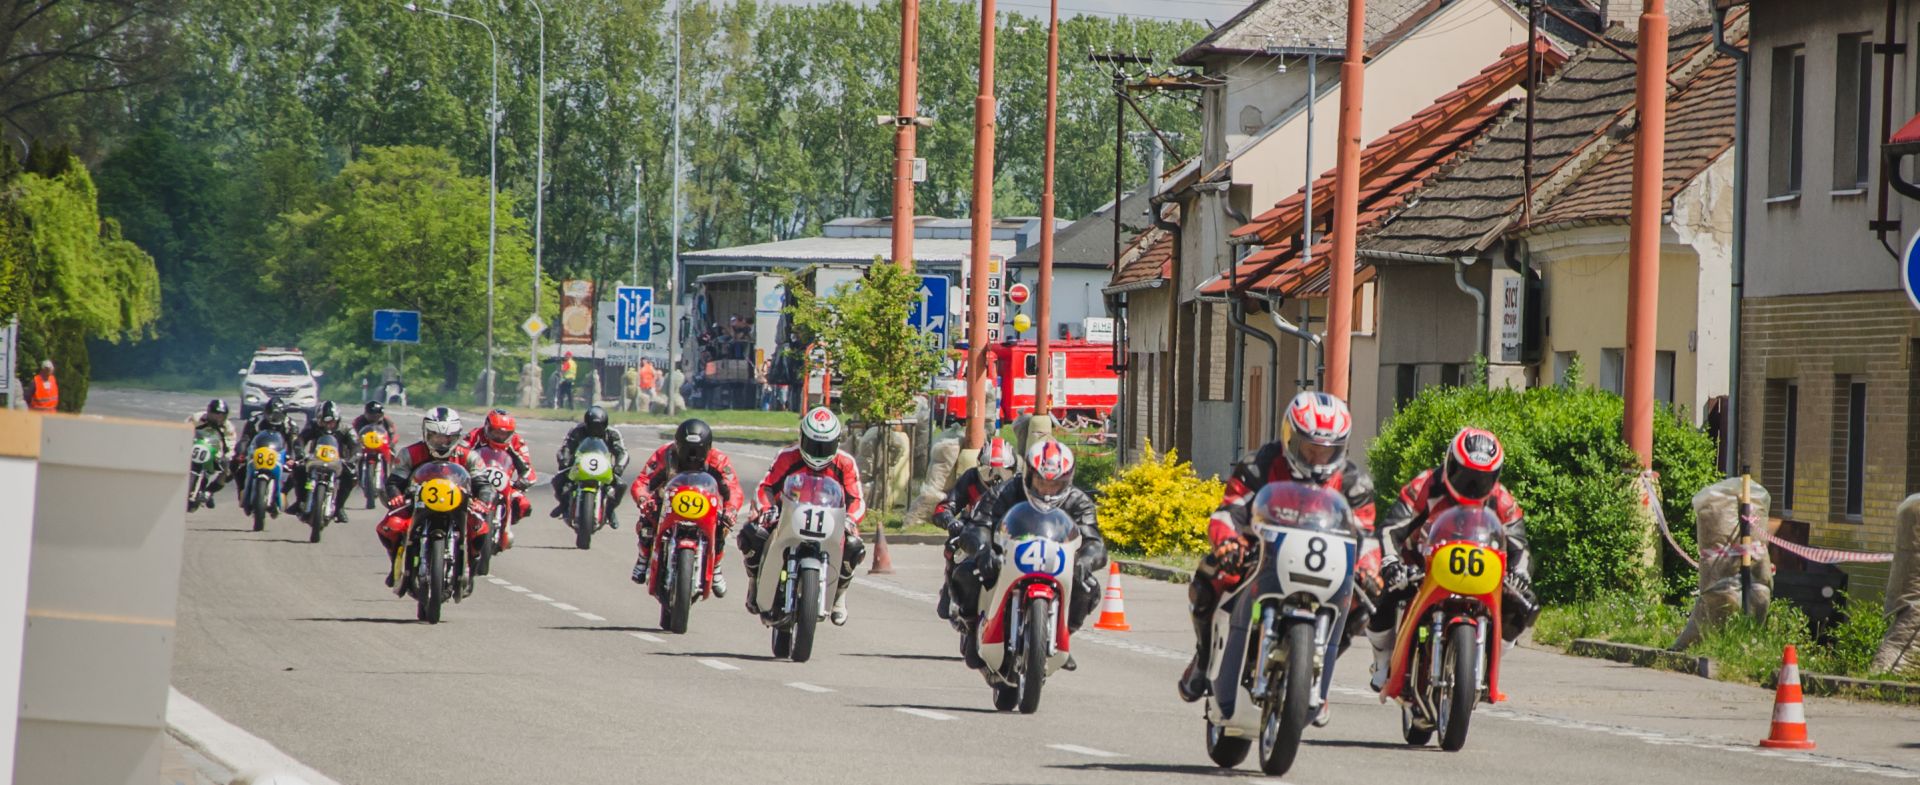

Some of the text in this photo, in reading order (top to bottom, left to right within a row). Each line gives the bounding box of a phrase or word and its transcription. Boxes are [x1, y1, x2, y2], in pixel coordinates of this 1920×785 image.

[256, 453, 275, 467] 88
[589, 458, 599, 472] 9
[678, 494, 704, 515] 89
[802, 508, 825, 533] 11
[1304, 536, 1328, 573] 8
[1449, 547, 1485, 577] 66
